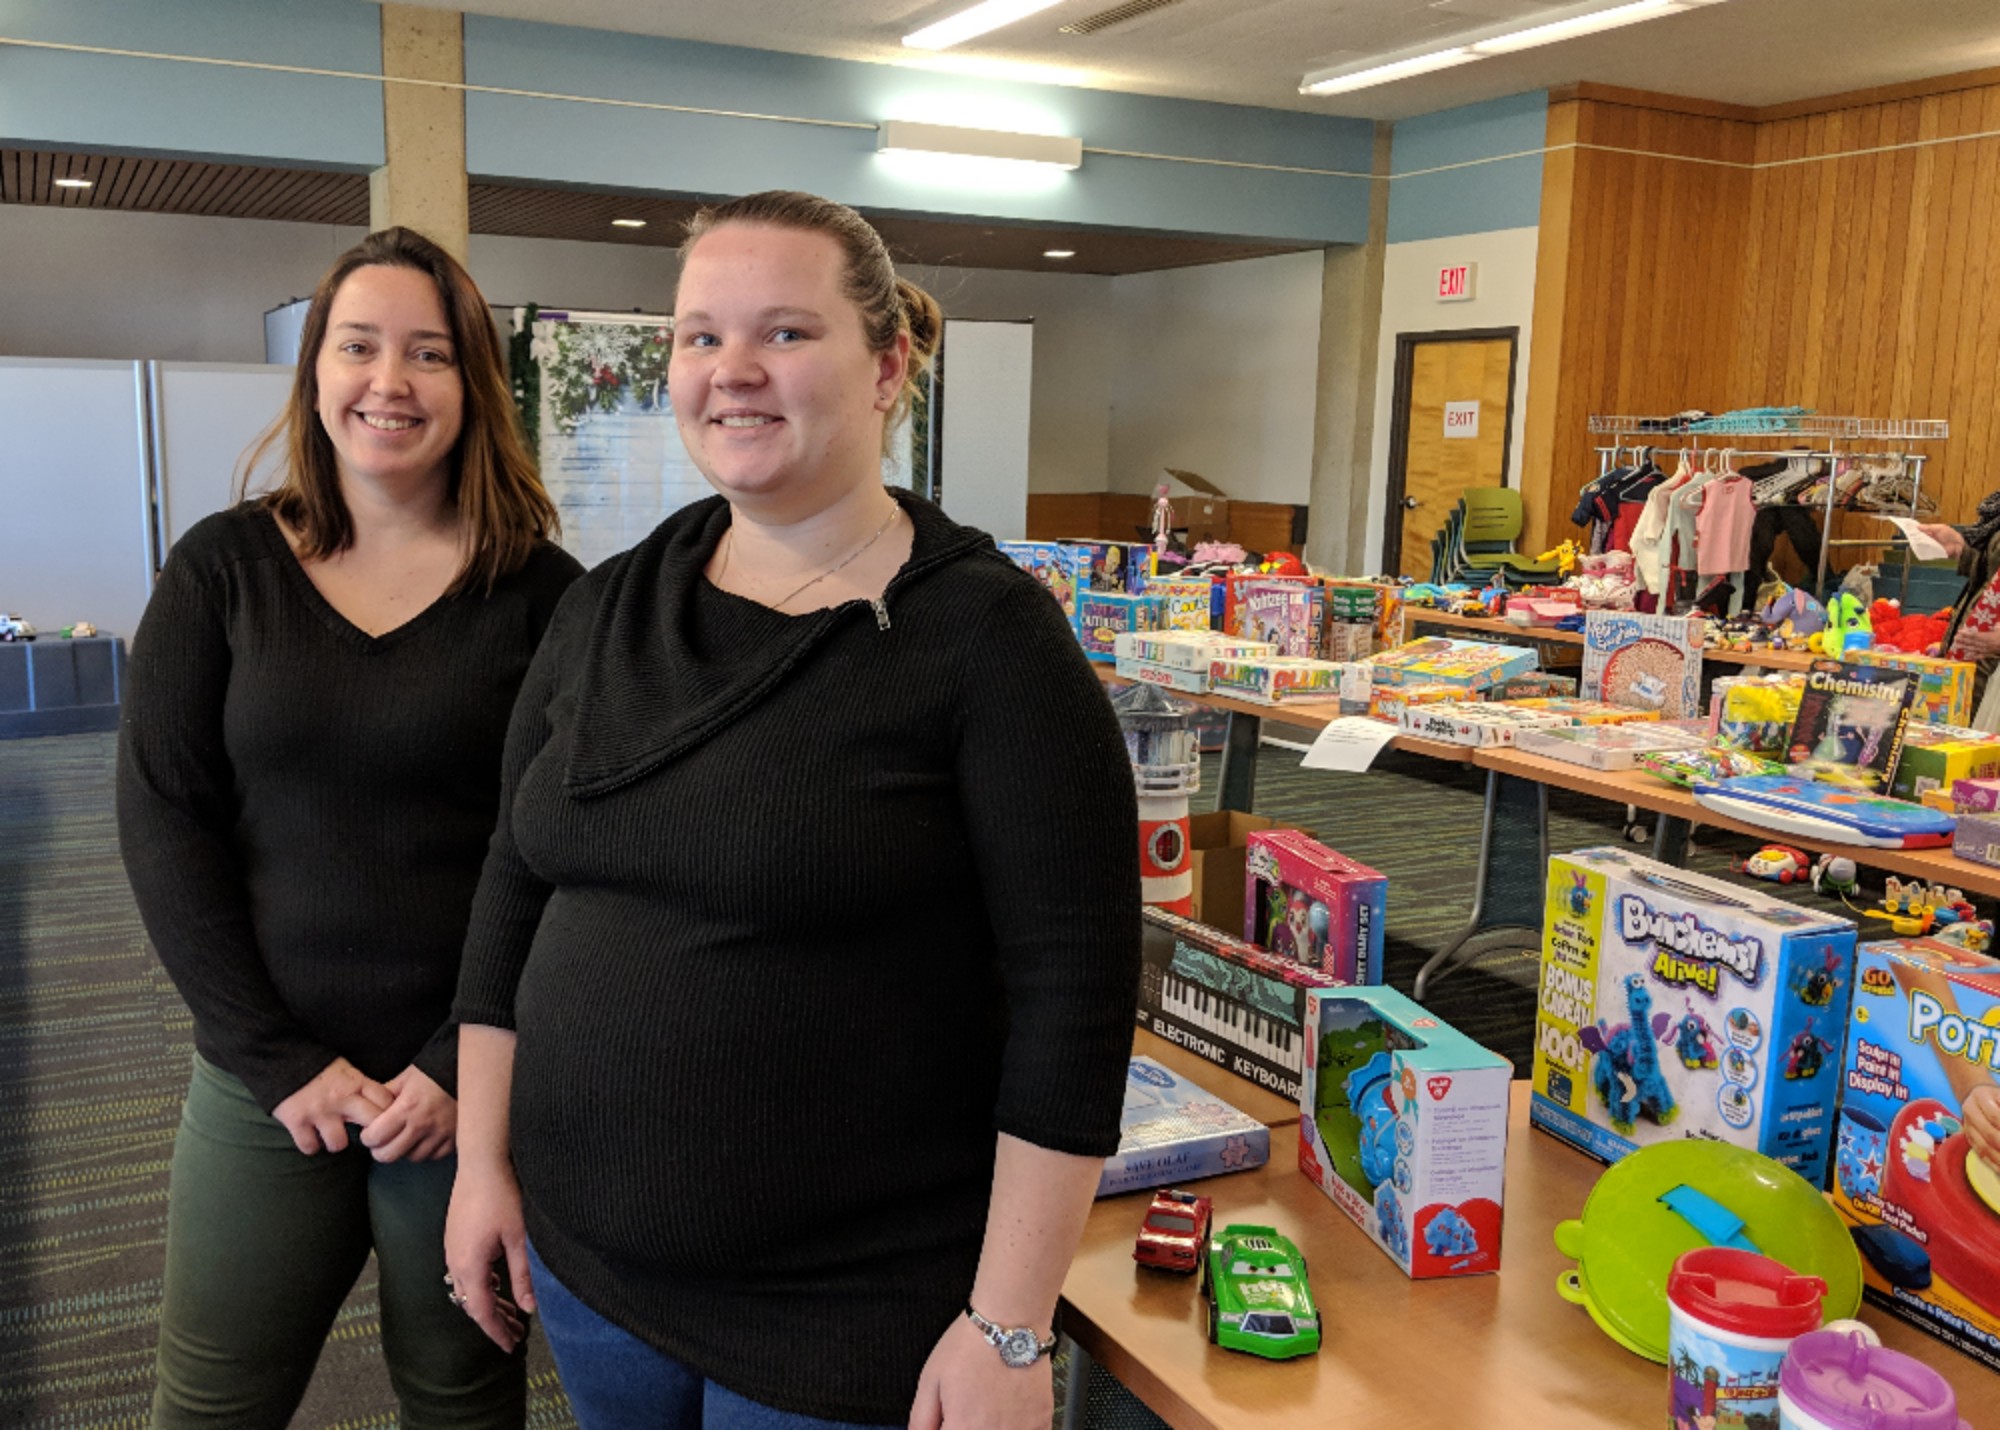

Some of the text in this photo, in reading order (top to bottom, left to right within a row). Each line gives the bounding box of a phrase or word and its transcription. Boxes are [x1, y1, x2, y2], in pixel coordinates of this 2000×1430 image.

[1439, 267, 1467, 296] EXIT
[1447, 412, 1475, 426] EXIT
[1810, 671, 1902, 707] Chemistry
[1622, 896, 1760, 980] Bunchems!
[1545, 961, 1593, 1005] BONUS
[1653, 951, 1718, 993] Alive!
[1864, 967, 1891, 985] GO
[1153, 1018, 1226, 1064] ELECTRONIC
[1858, 1040, 1889, 1062] Sculpt
[1858, 1057, 1888, 1077] Paint
[1849, 1072, 1893, 1097] Display
